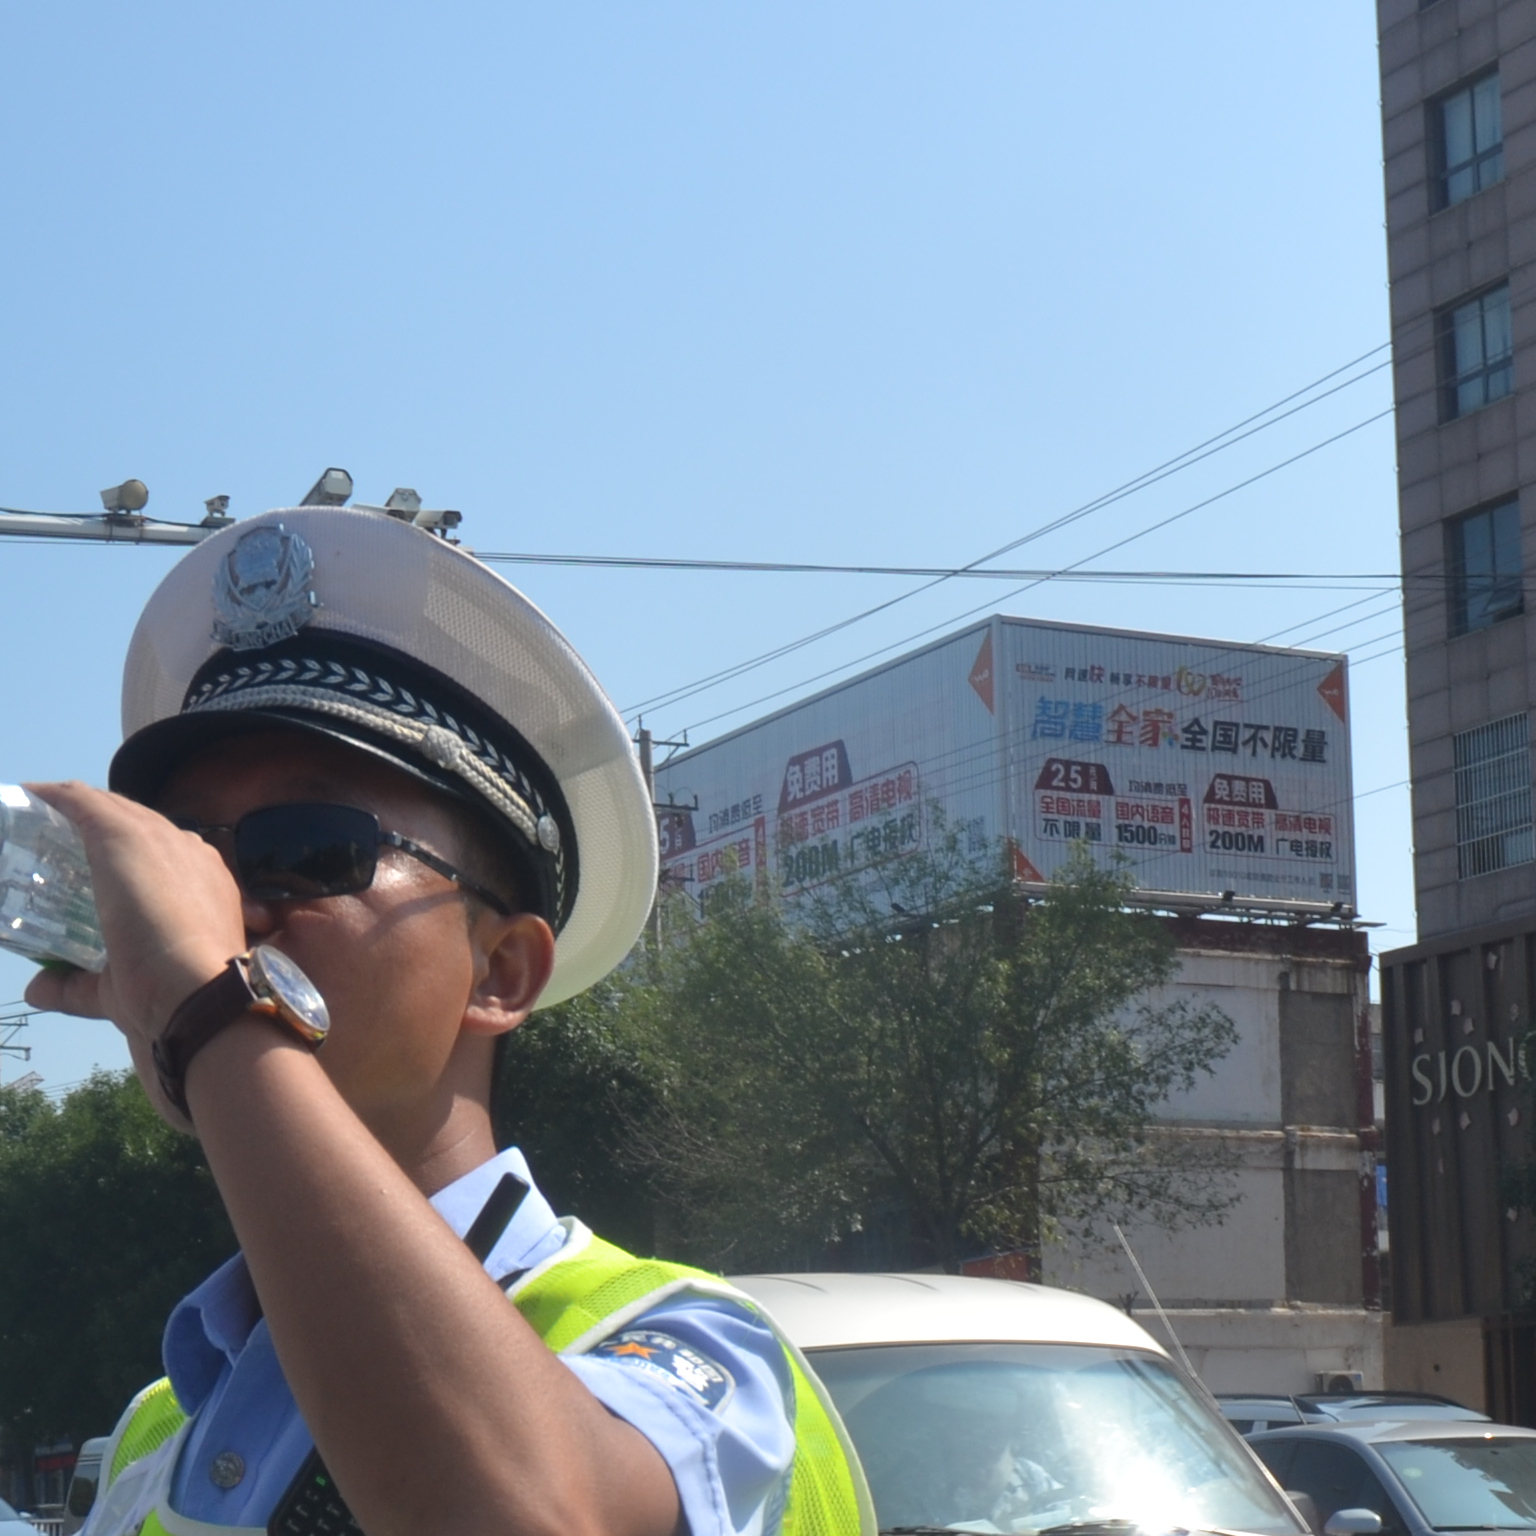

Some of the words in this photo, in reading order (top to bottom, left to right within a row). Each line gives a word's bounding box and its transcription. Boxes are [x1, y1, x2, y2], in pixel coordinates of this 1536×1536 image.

[1180, 717, 1328, 764] 全国不限量
[786, 743, 840, 801] 免费用
[1050, 763, 1082, 789] 25
[1215, 778, 1264, 804] 免费用
[1041, 795, 1102, 819] 全国流量
[1116, 802, 1176, 826] 国内语音
[1206, 806, 1265, 828] 极速宽带
[1275, 813, 1333, 836] 高清电视
[1042, 818, 1102, 842] 不限量
[1208, 829, 1264, 855] 200M
[697, 836, 751, 884] 国内音
